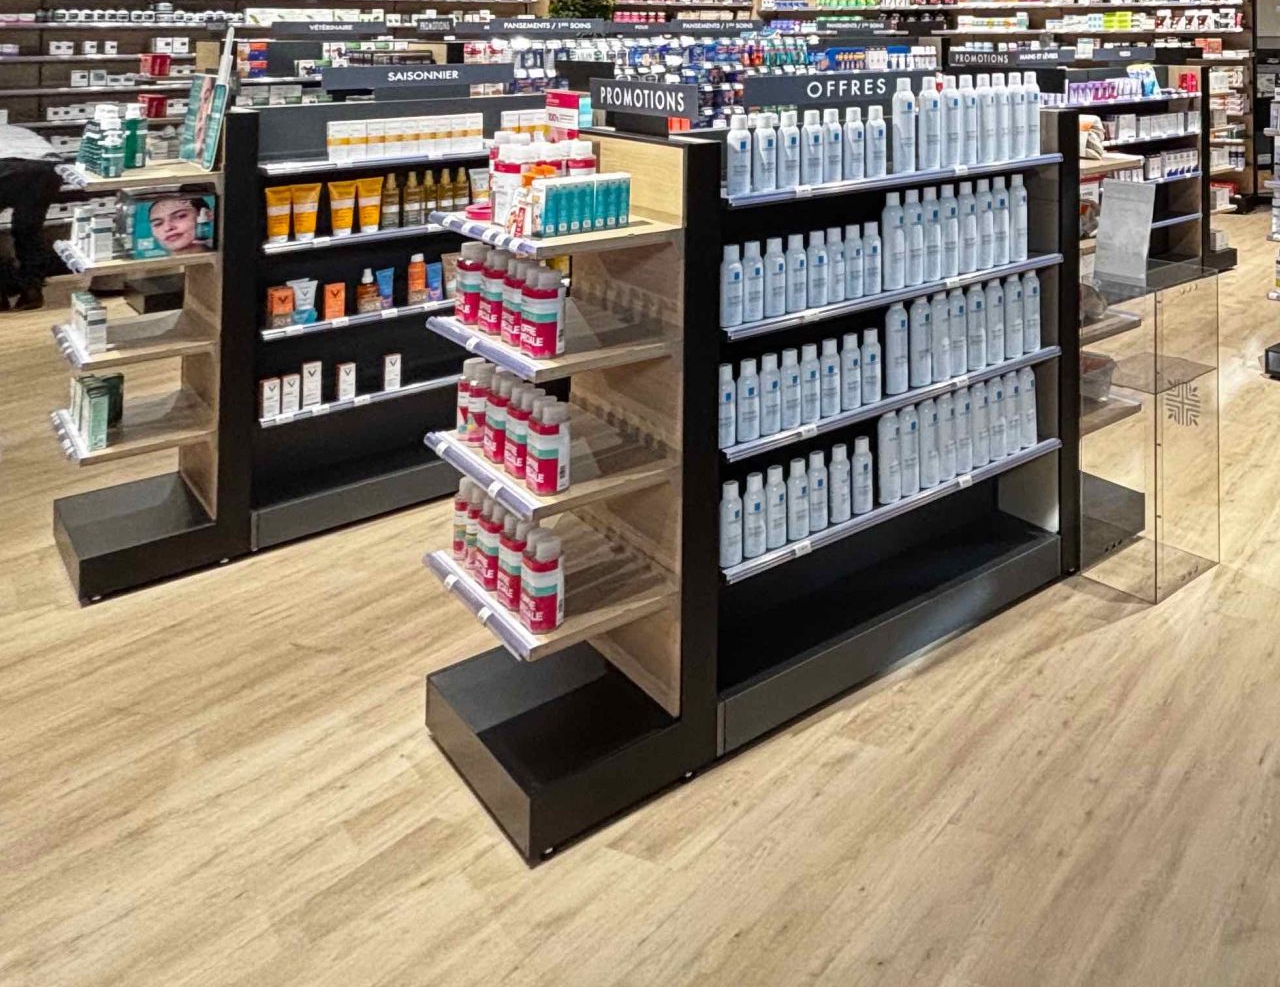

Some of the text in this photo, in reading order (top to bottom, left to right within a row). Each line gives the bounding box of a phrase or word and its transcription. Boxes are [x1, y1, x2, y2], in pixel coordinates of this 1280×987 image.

[955, 53, 1008, 63] PROMOTIONS
[388, 70, 459, 82] SAISONNIER
[807, 78, 886, 99] OFFRES
[600, 86, 685, 112] PROMOTIONS
